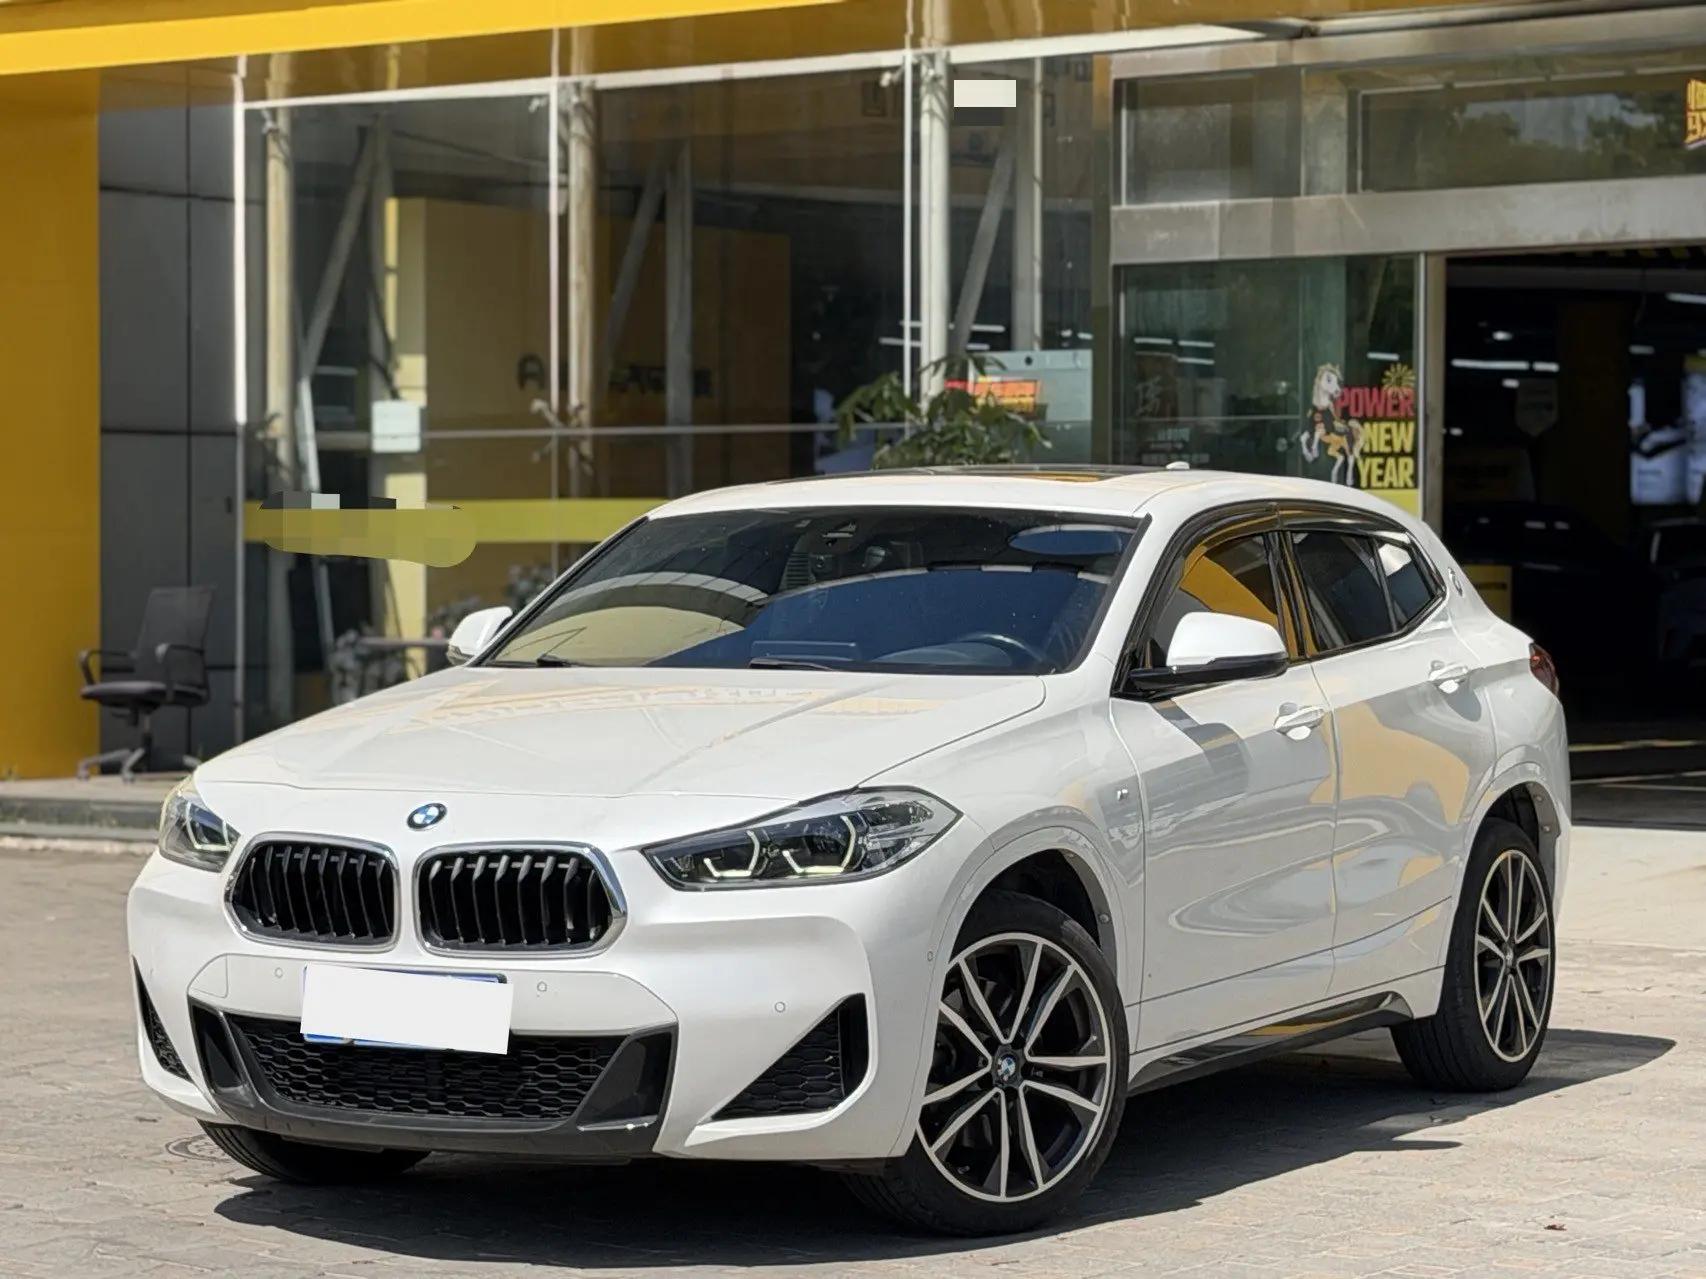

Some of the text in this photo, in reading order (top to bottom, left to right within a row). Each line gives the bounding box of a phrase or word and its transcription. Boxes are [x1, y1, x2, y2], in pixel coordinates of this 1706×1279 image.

[1336, 387, 1415, 418] POWER
[1363, 421, 1415, 453] NEW
[1357, 456, 1415, 489] YEAR
